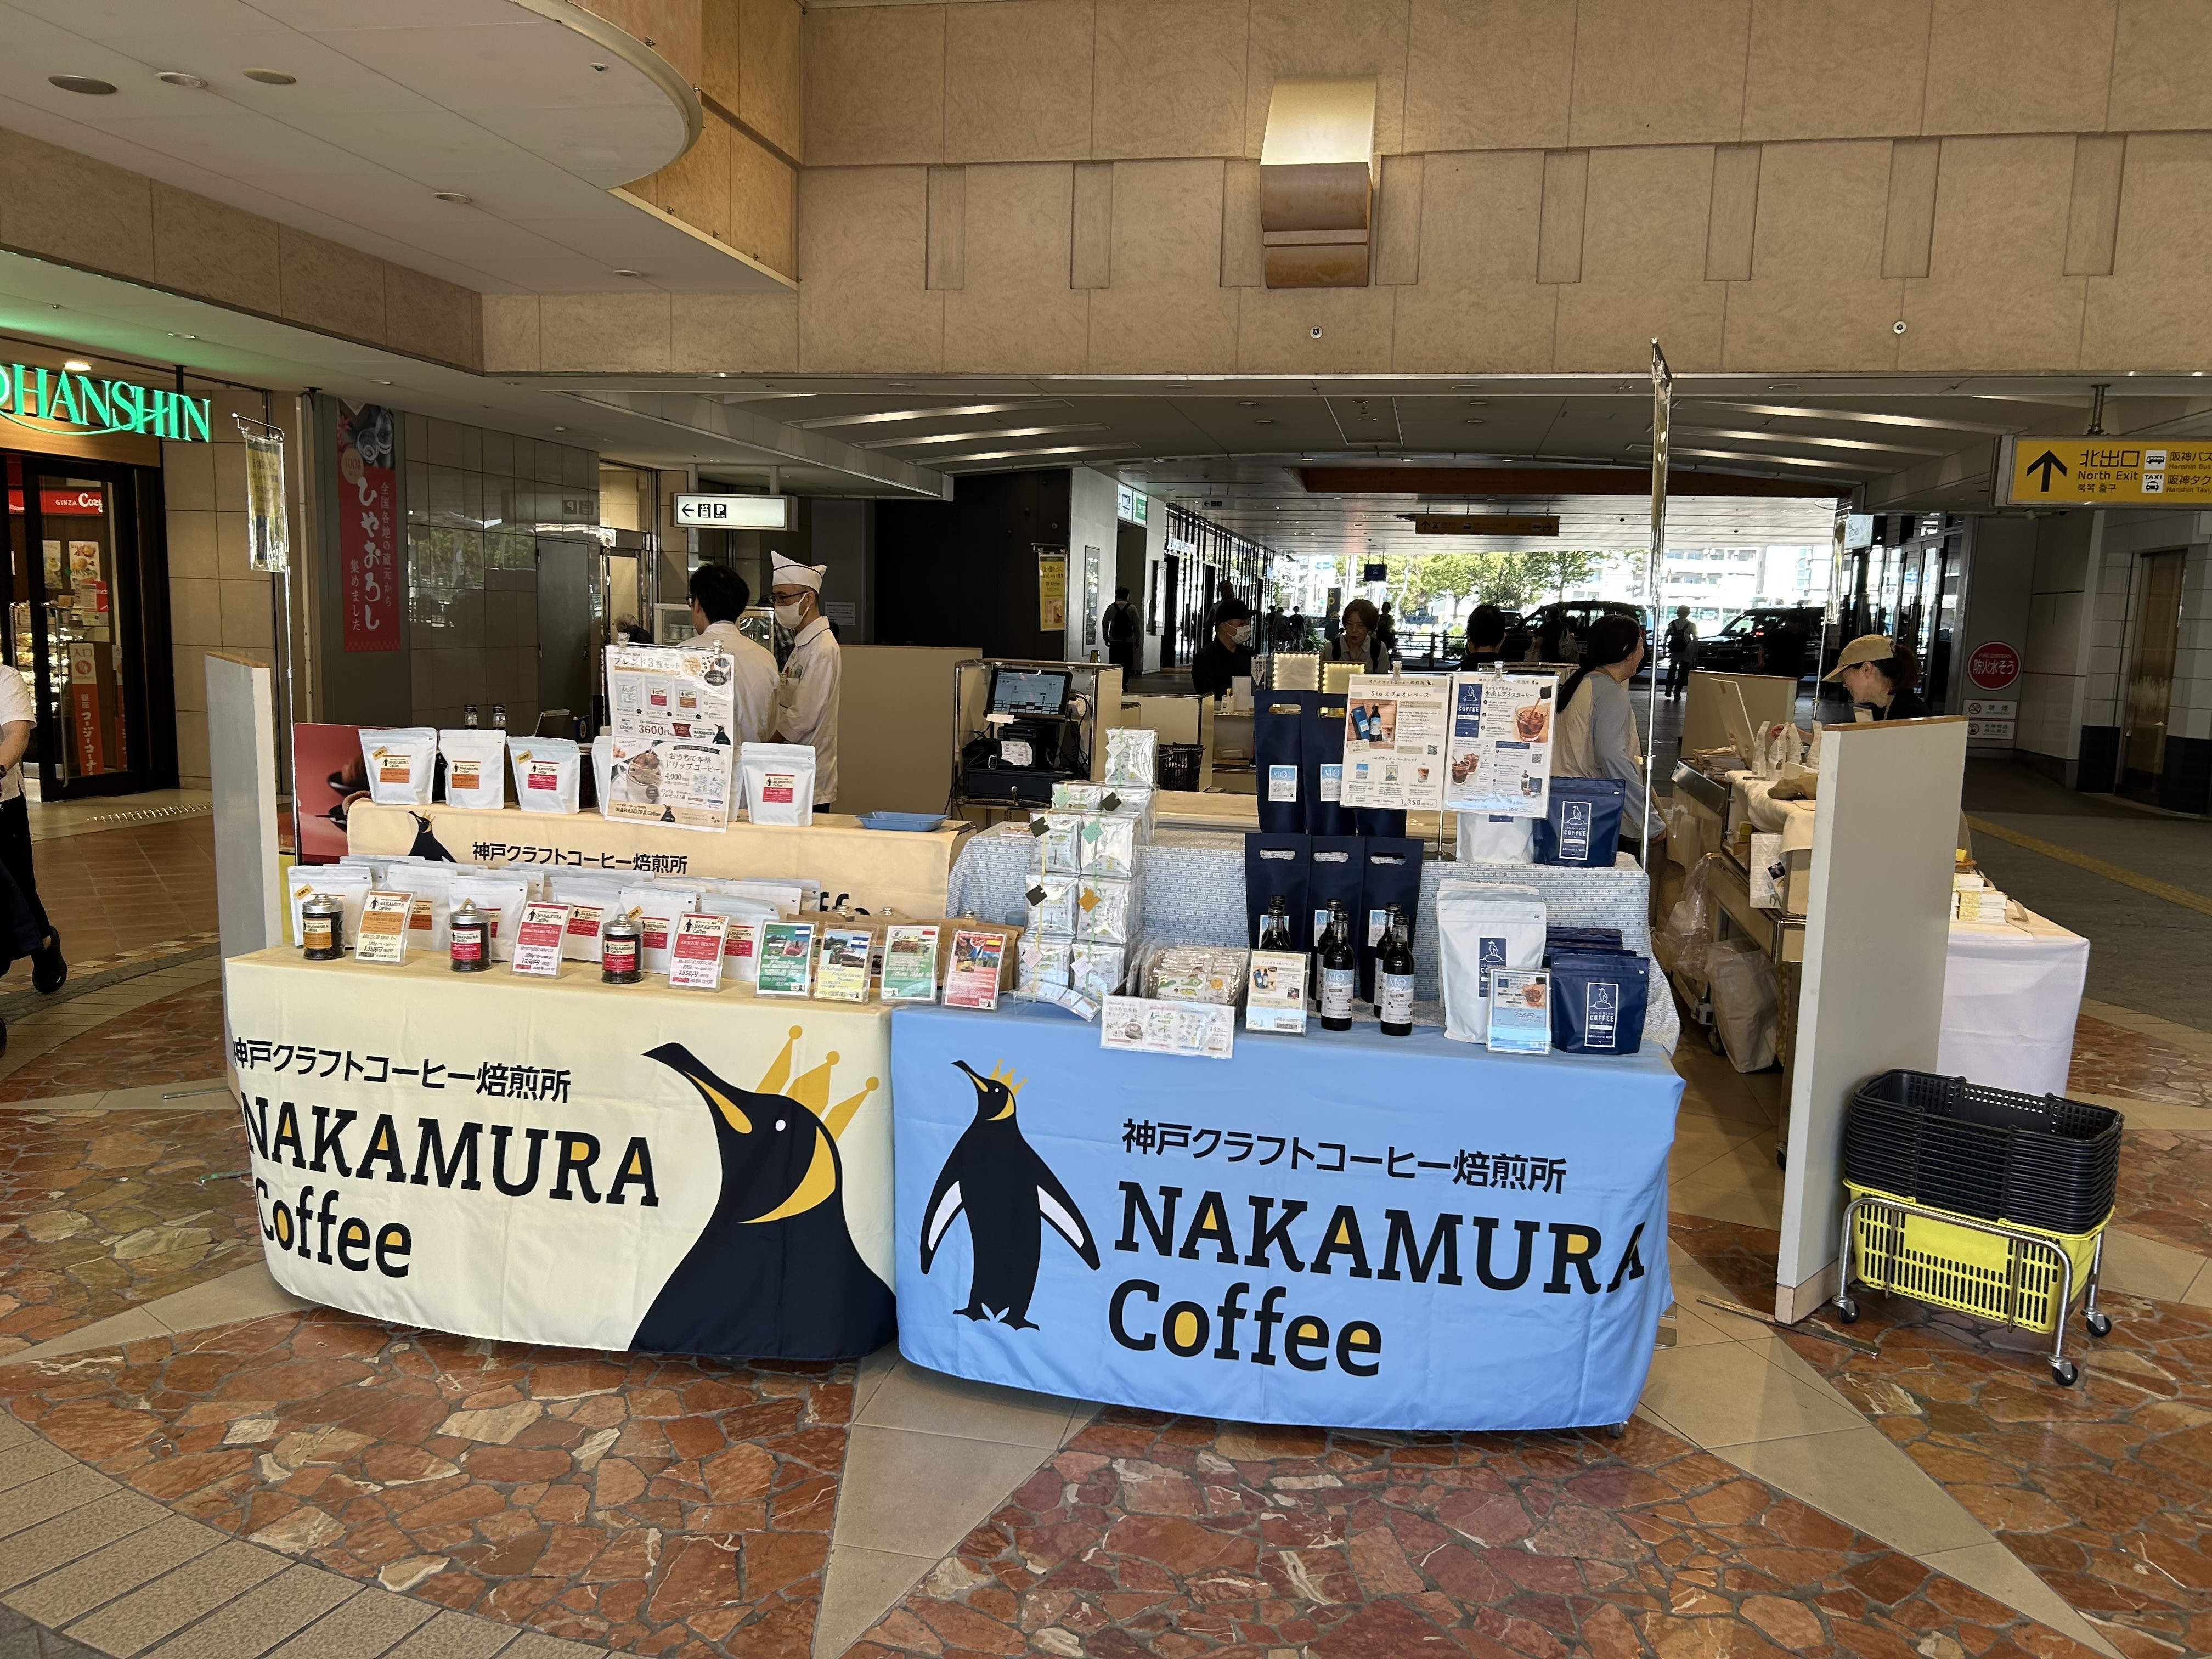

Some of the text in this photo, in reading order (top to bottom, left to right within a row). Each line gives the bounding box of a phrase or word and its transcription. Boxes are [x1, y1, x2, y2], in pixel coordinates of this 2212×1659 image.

[11, 363, 211, 443] HANSHIN
[2079, 449, 2140, 467] 北出口
[2169, 451, 2212, 462] 阪神バス
[2078, 471, 2138, 481] North Exit
[2167, 475, 2211, 485] 阪神タク
[2077, 483, 2116, 493] 북쪽 출구
[78, 493, 104, 513] Cozy
[716, 505, 724, 515] P
[357, 476, 381, 632] ひやおろし
[380, 482, 392, 607] 全国各地の蔵元から
[349, 558, 361, 631] 集めました
[1328, 597, 1335, 609] P
[73, 648, 93, 657] 入口
[1973, 659, 2015, 675] 防火水そう
[669, 753, 712, 764] おうちで本格
[616, 806, 647, 816] NAKAMURA
[472, 842, 688, 875] 神戸クラフトコーヒー焙煎所
[233, 1036, 572, 1103] 神戸クラフトコーヒー焙煎所
[241, 1091, 660, 1207] NAKAMURA
[1121, 1118, 1568, 1195] 神戸クラフトコーヒー焙煎所
[255, 1177, 412, 1279] Coffee
[1114, 1180, 1645, 1295] NAKAMURA
[1108, 1278, 1383, 1376] Coffee
